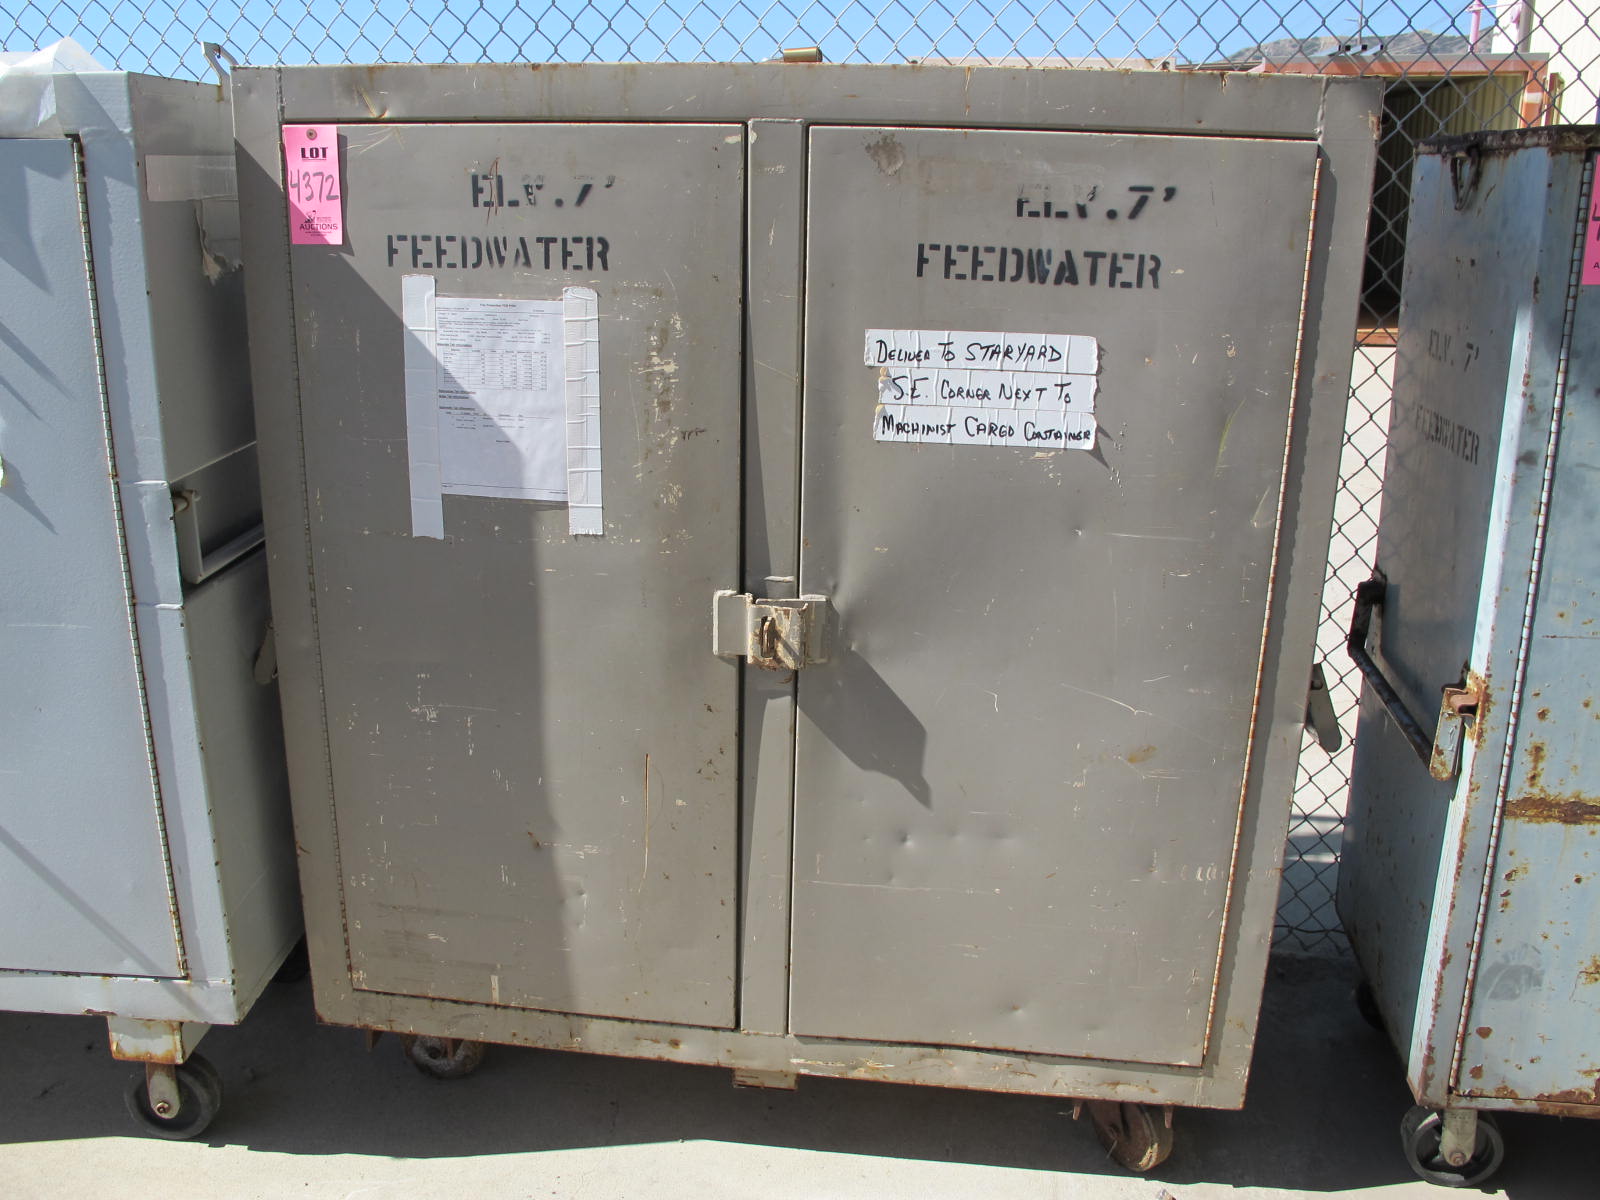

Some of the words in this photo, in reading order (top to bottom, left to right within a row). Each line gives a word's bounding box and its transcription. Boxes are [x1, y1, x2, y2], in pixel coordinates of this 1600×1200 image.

[300, 147, 328, 159] LOT
[290, 169, 340, 203] 4372
[299, 223, 339, 231] AUCTIONS
[386, 234, 610, 271] FEEDWATER
[916, 243, 1162, 289] FEEDWATER
[964, 342, 1062, 363] STARYARD
[891, 375, 929, 401] S.E.
[999, 382, 1048, 402] NEXT
[881, 414, 956, 436] MACHINIST
[964, 416, 1015, 438] CARGO
